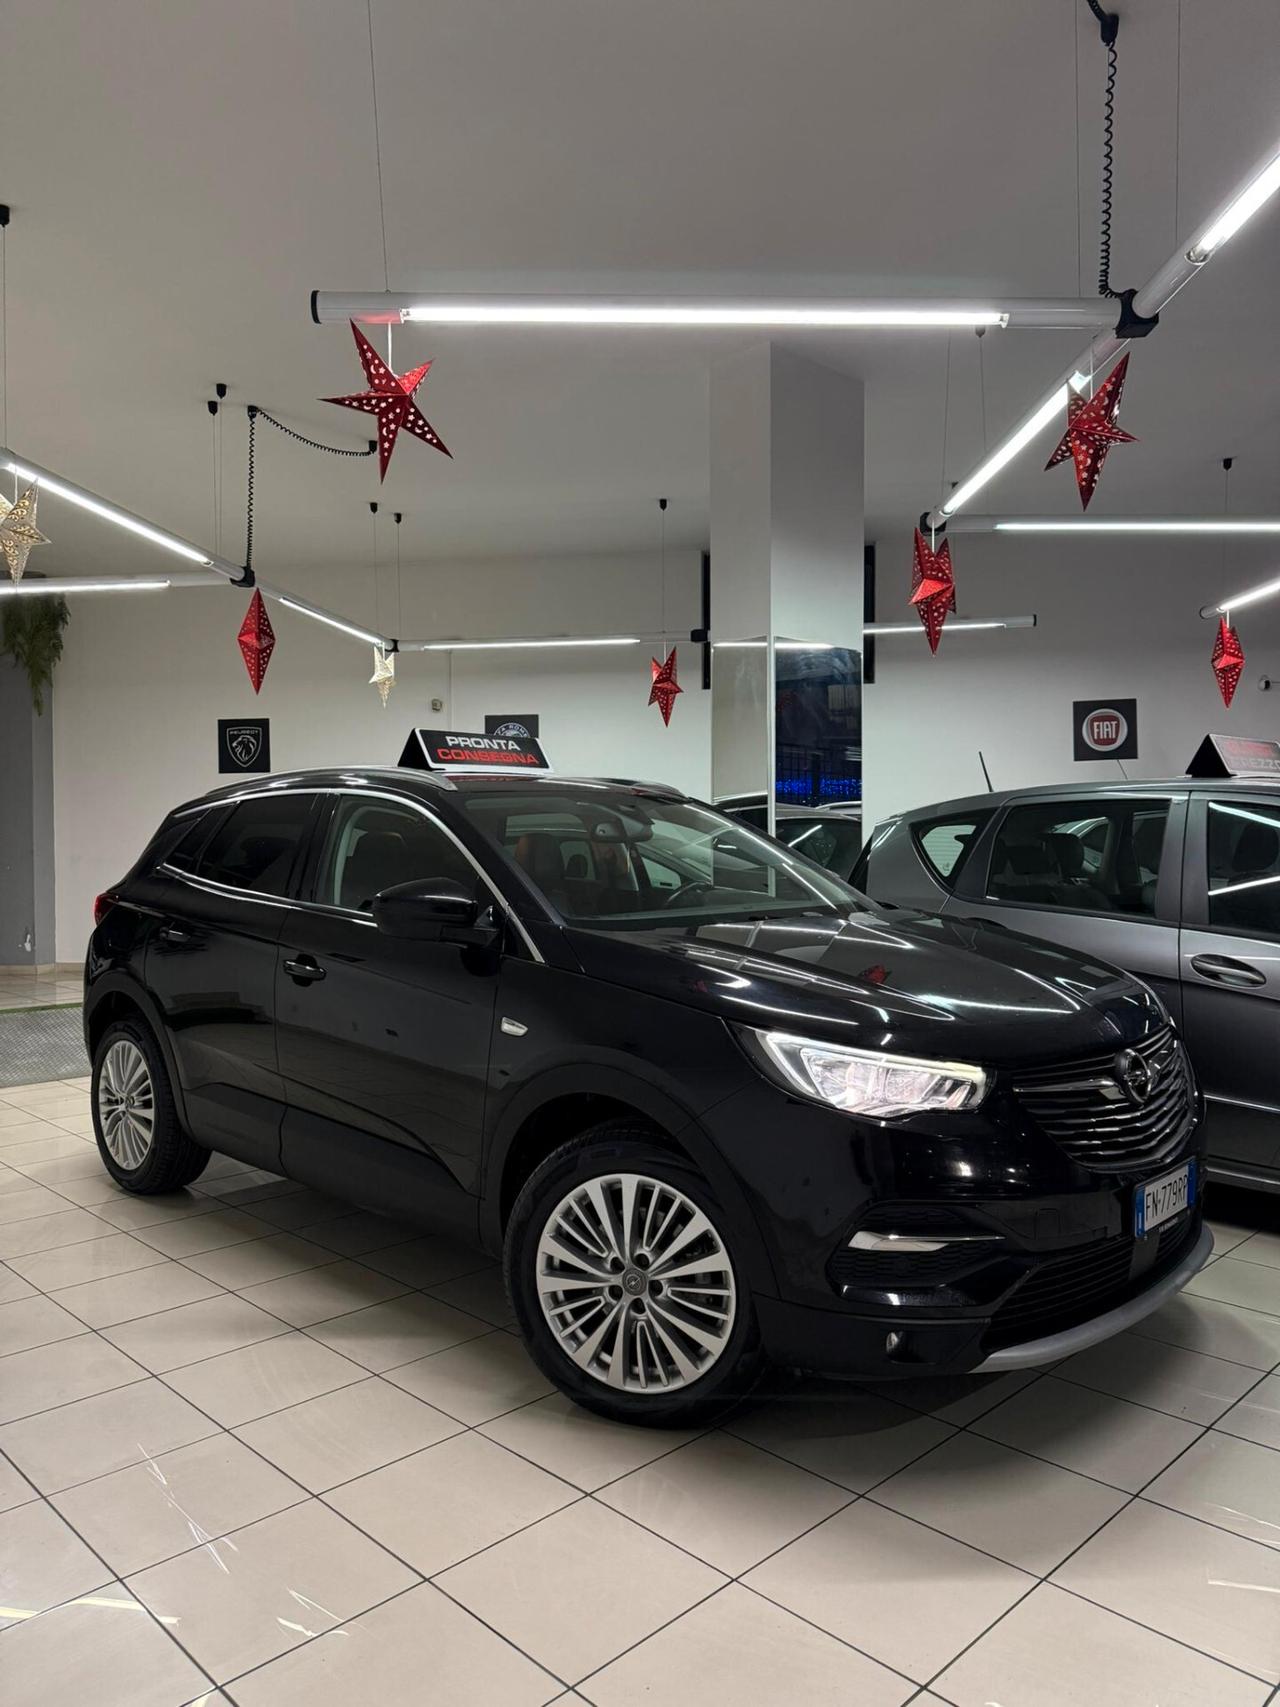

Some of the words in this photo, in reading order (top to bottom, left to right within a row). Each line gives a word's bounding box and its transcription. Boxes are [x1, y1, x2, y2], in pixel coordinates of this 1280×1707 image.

[1093, 721, 1118, 740] FIAT
[445, 736, 521, 751] PRONTA
[436, 748, 539, 764] CONSEGNA
